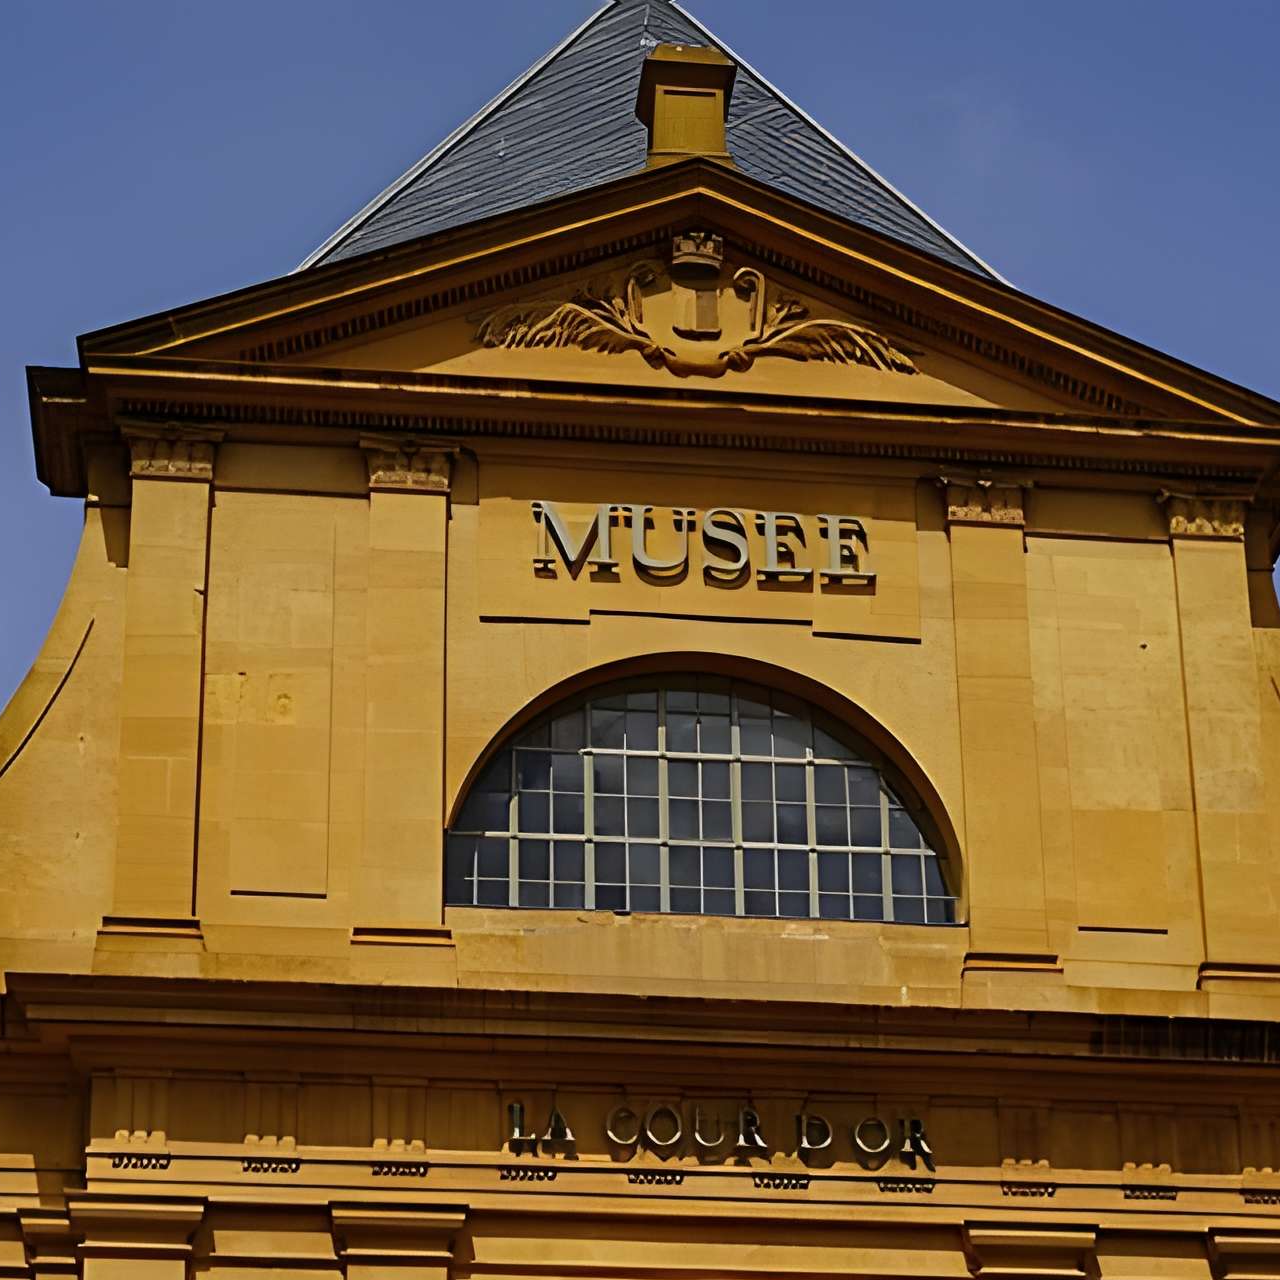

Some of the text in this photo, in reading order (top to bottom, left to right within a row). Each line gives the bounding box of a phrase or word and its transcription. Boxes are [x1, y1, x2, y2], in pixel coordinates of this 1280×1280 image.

[531, 500, 877, 582] MUSEE
[508, 1102, 576, 1142] LA
[606, 1104, 768, 1148] COUR
